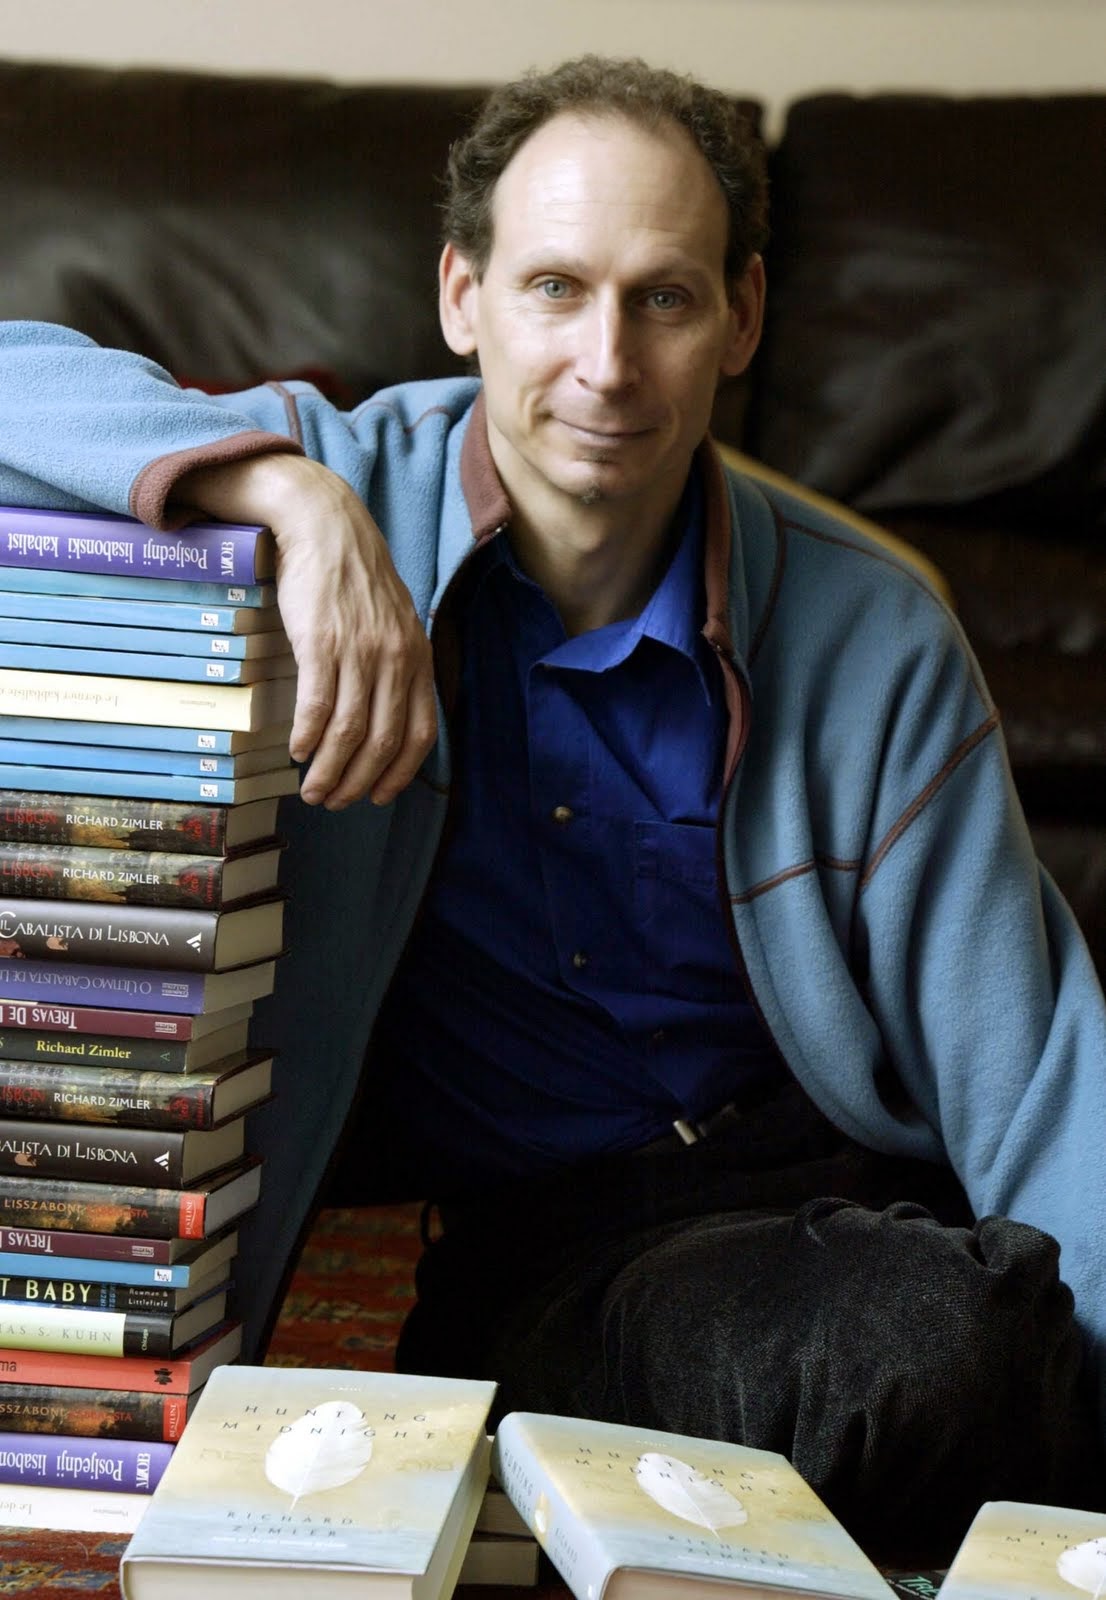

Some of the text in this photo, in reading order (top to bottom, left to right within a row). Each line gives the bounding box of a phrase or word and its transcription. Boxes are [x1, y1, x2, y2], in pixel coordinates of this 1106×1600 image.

[8, 532, 208, 569] Posljednji lisabonski kabalist
[66, 813, 163, 831] RICHARD ZIMLER
[62, 867, 160, 885] RICHARD ZIMLER
[88, 927, 103, 941] DI
[107, 925, 170, 946] LISBONA
[12, 970, 26, 982] DE
[29, 973, 90, 991] CABALISTA
[139, 981, 152, 995] O
[32, 1009, 78, 1030] TREVAS
[37, 1040, 131, 1059] Richard Zimler
[53, 1092, 151, 1110] RICHARD ZIMLER
[57, 1145, 71, 1157] DI
[75, 1143, 138, 1164] LISBONA
[8, 1232, 53, 1253] TREVAS
[26, 1280, 92, 1303] BABY
[128, 1299, 168, 1307] Littlefield
[62, 1330, 113, 1342] KUHN
[244, 1405, 430, 1422] HUNTING
[222, 1422, 435, 1440] MIDNIGHT
[57, 1450, 124, 1482] Posljednji
[226, 1511, 353, 1525] RICHARD
[231, 1526, 337, 1537] ZIMLER
